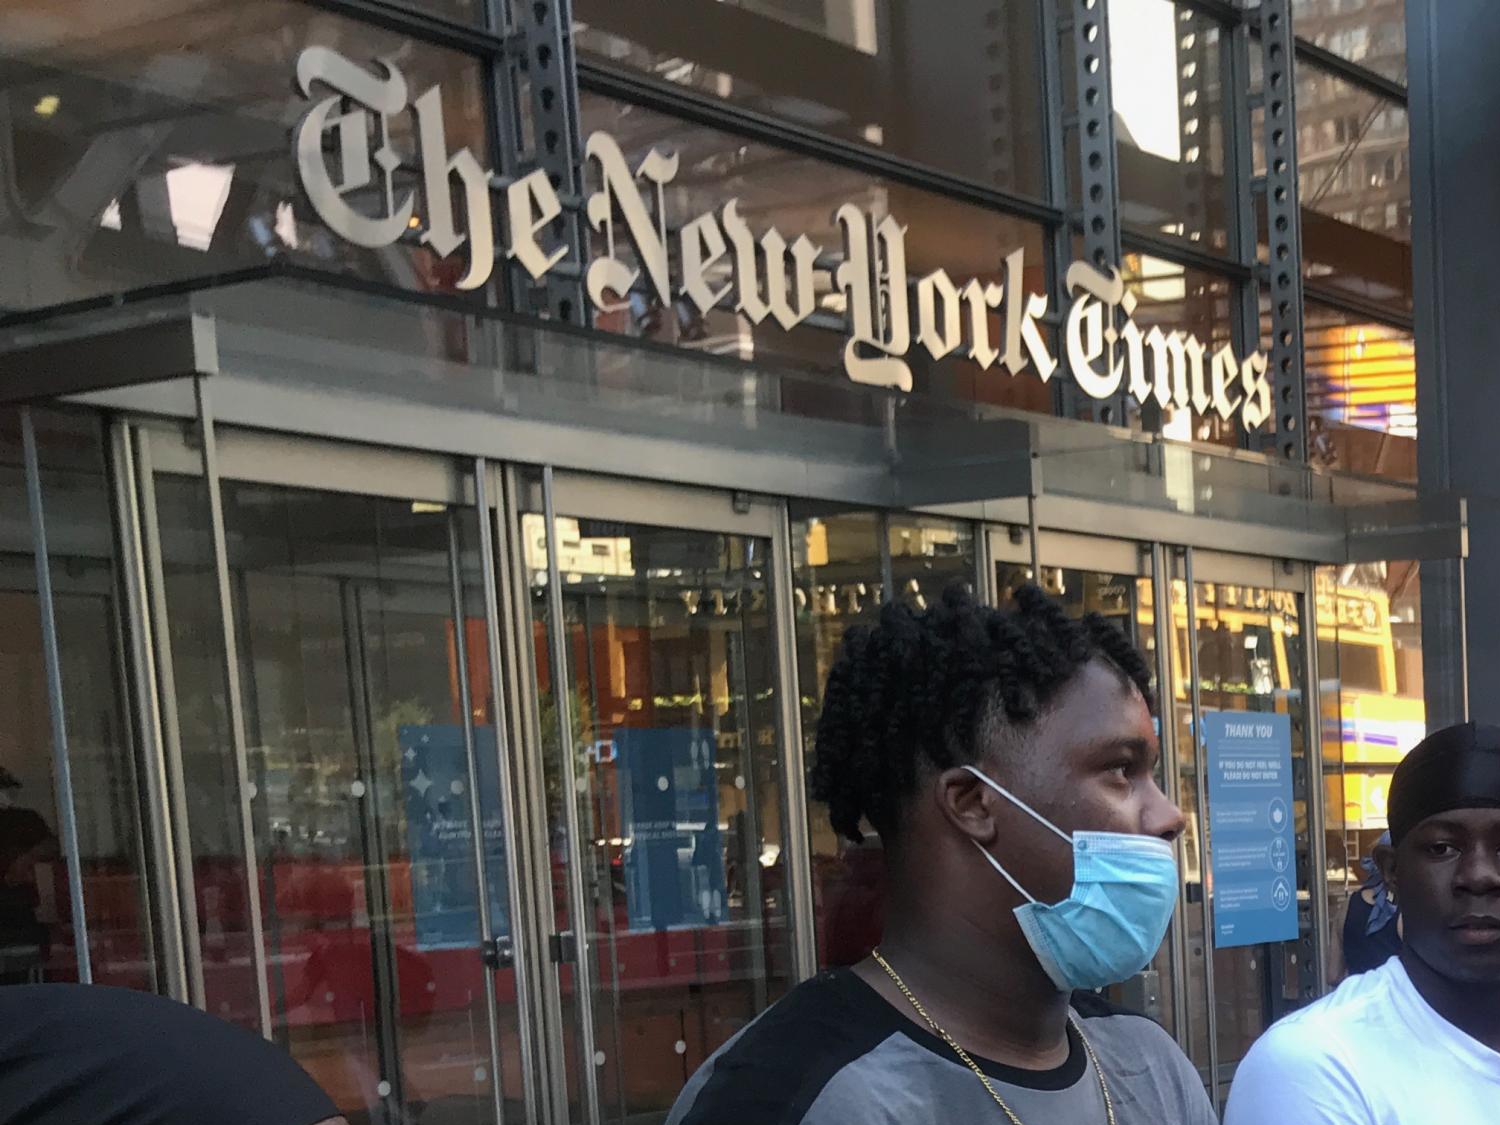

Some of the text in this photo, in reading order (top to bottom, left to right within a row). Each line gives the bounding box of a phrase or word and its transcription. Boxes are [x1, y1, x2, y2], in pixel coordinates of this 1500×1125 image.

[297, 45, 1271, 432] The New York Times
[1225, 724, 1273, 738] THANK YOU
